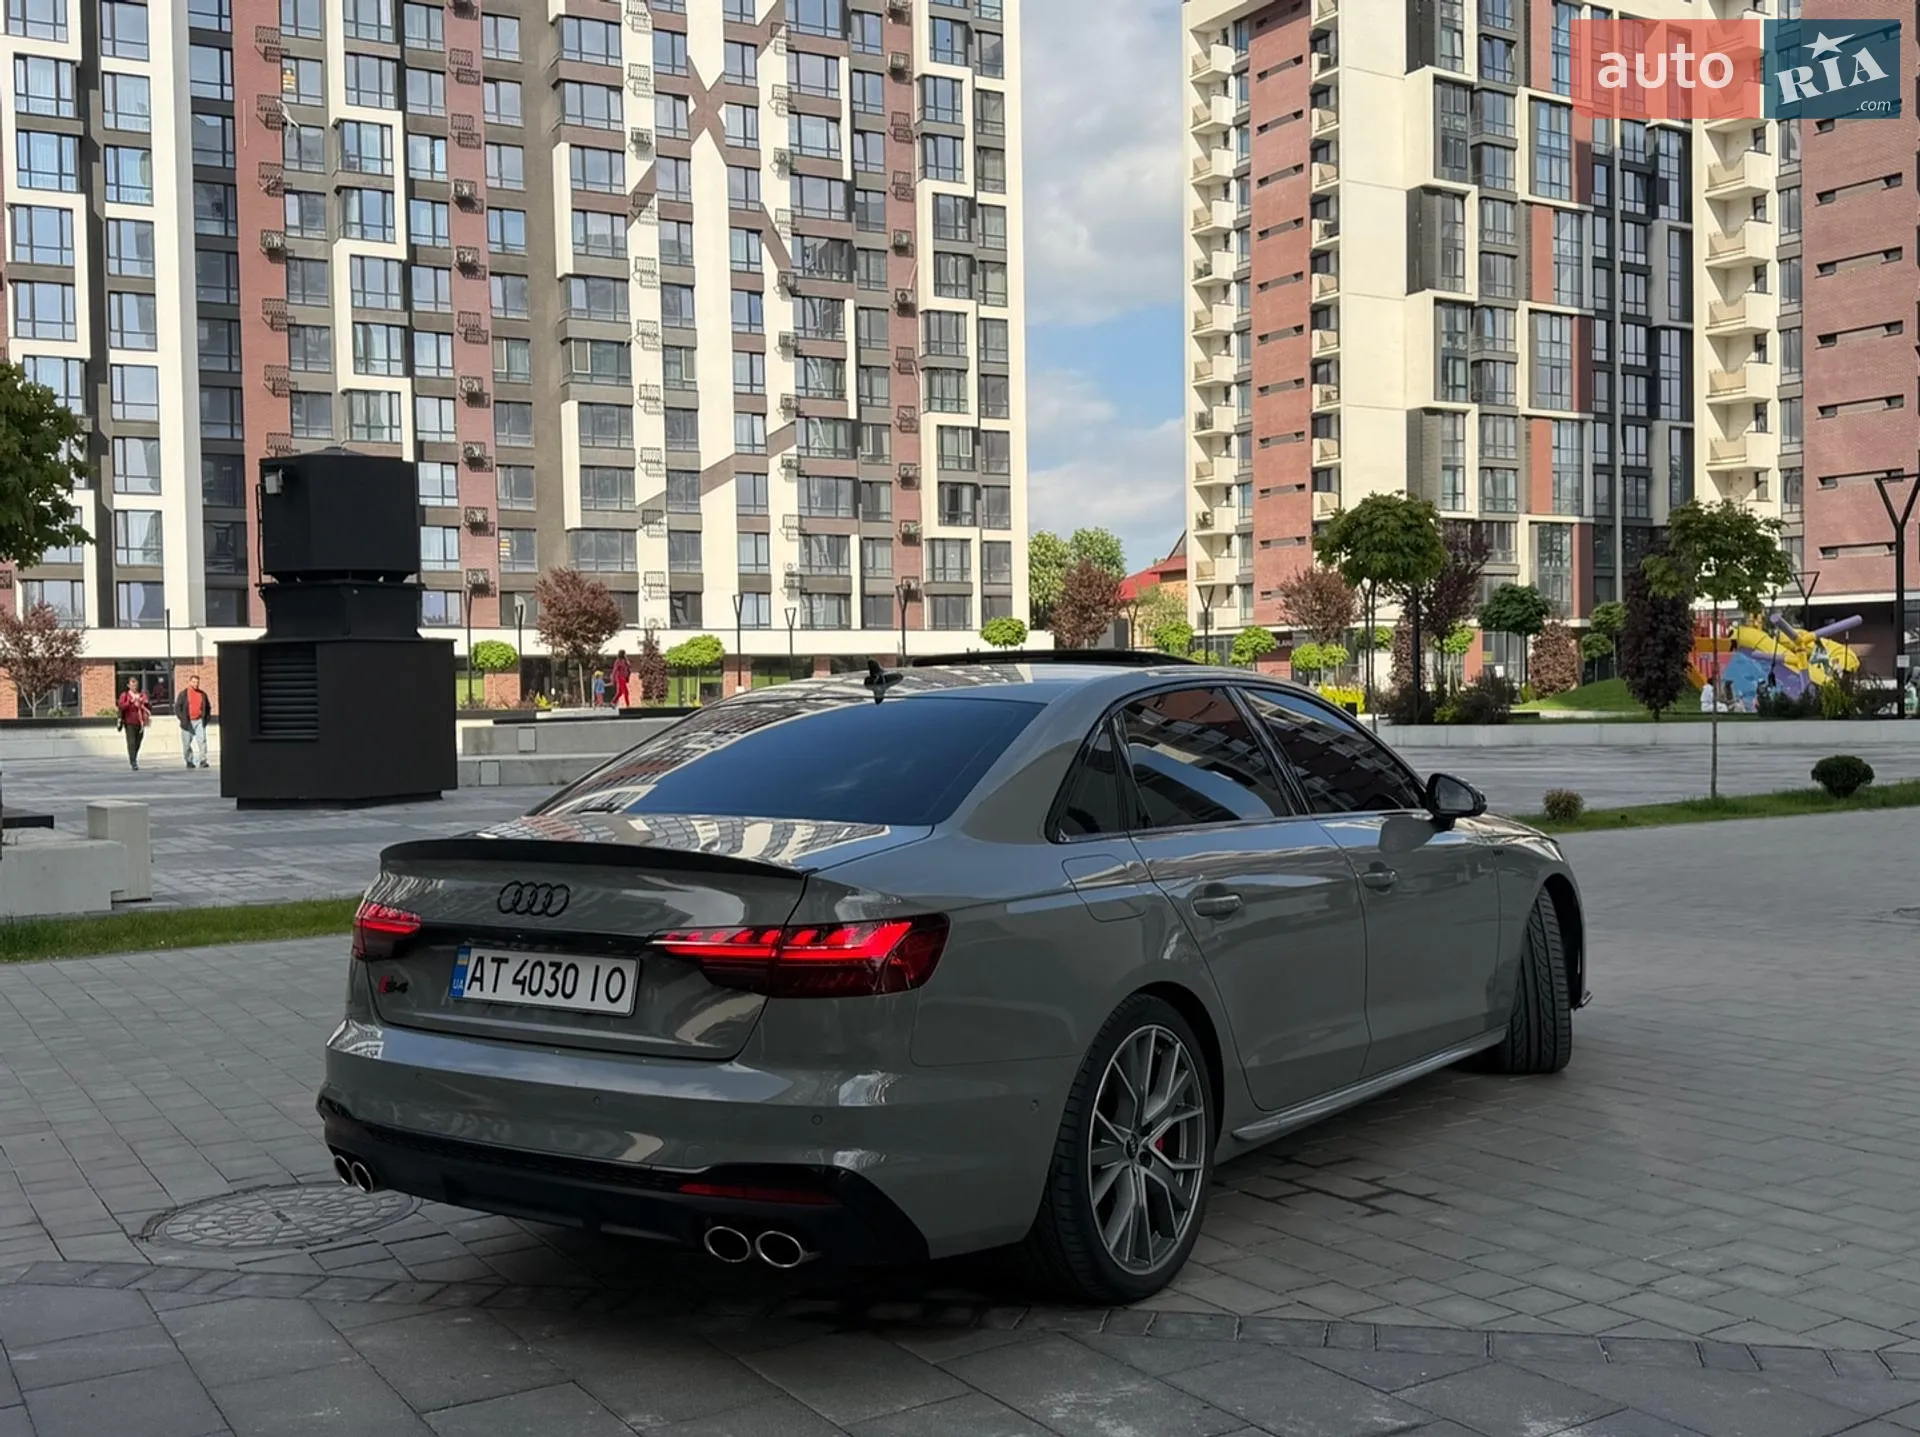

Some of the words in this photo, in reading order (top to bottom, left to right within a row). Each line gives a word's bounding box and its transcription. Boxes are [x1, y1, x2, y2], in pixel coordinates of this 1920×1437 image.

[467, 956, 509, 993] AT
[512, 959, 579, 999] 4030
[590, 965, 627, 1004] IO
